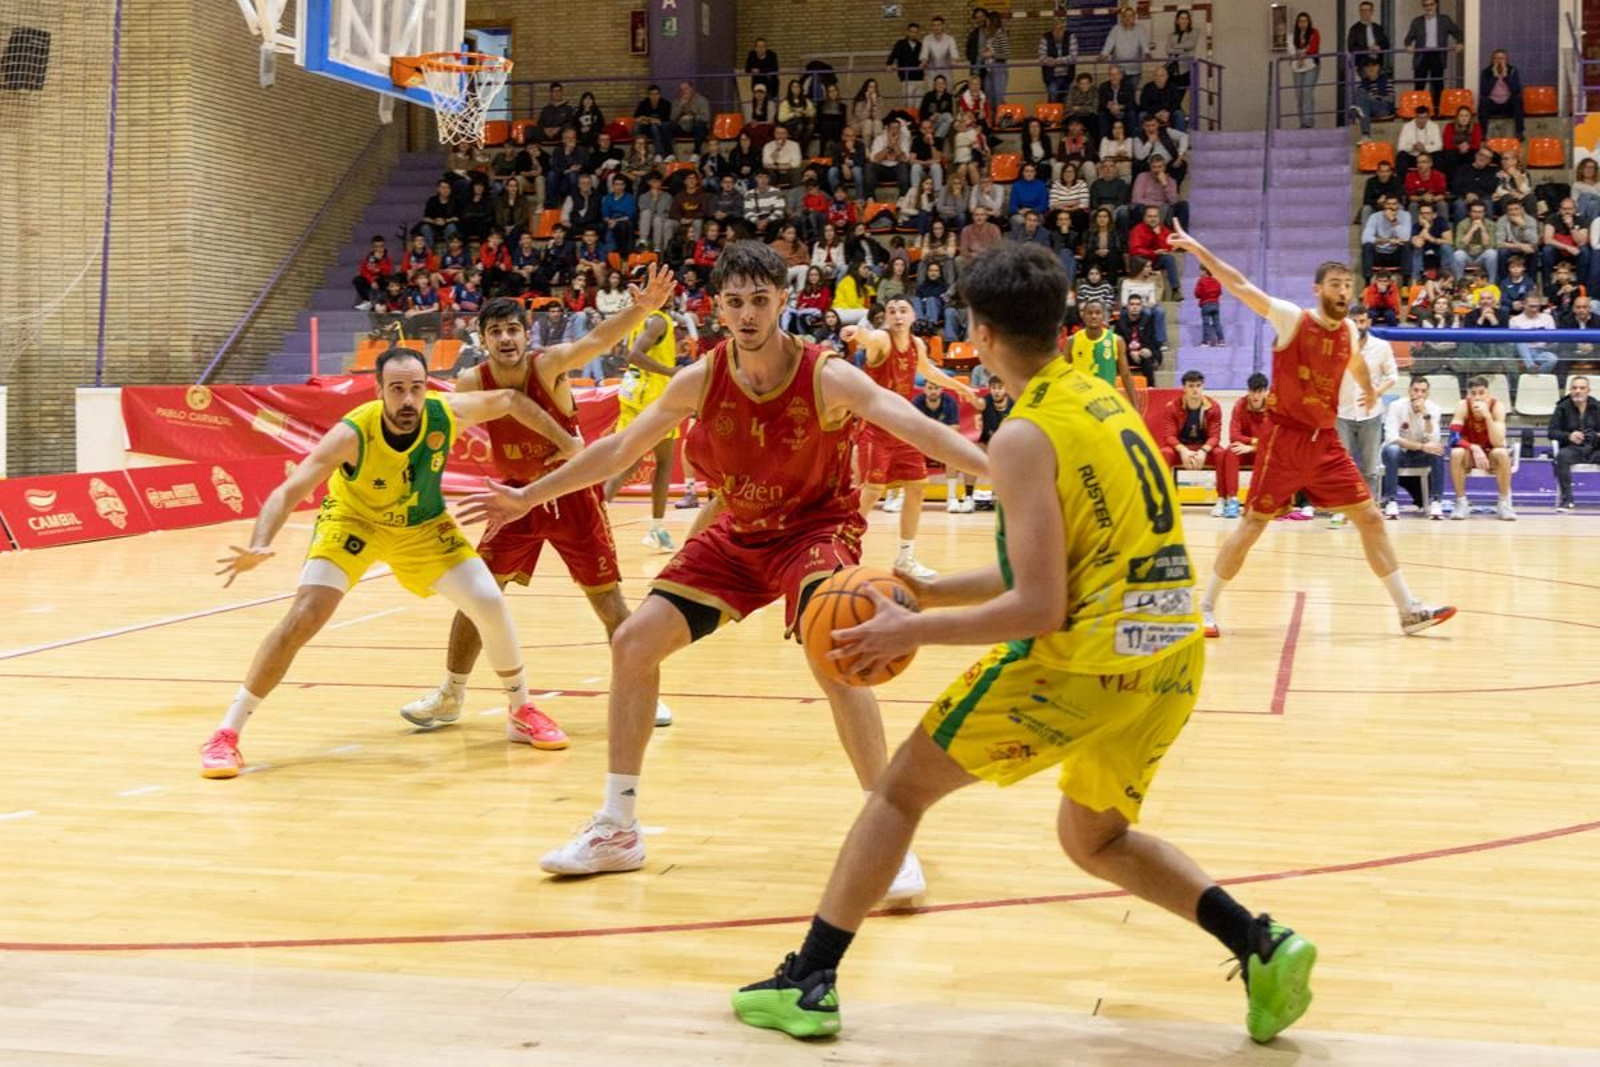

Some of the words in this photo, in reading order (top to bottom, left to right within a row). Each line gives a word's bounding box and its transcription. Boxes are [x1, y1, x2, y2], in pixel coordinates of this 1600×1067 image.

[1322, 338, 1334, 355] 11
[751, 417, 766, 447] 4
[733, 474, 783, 501] Jaén
[1120, 428, 1174, 534] 0
[1078, 464, 1112, 529] RUSTER
[598, 556, 608, 570] 2
[810, 547, 820, 558] 4
